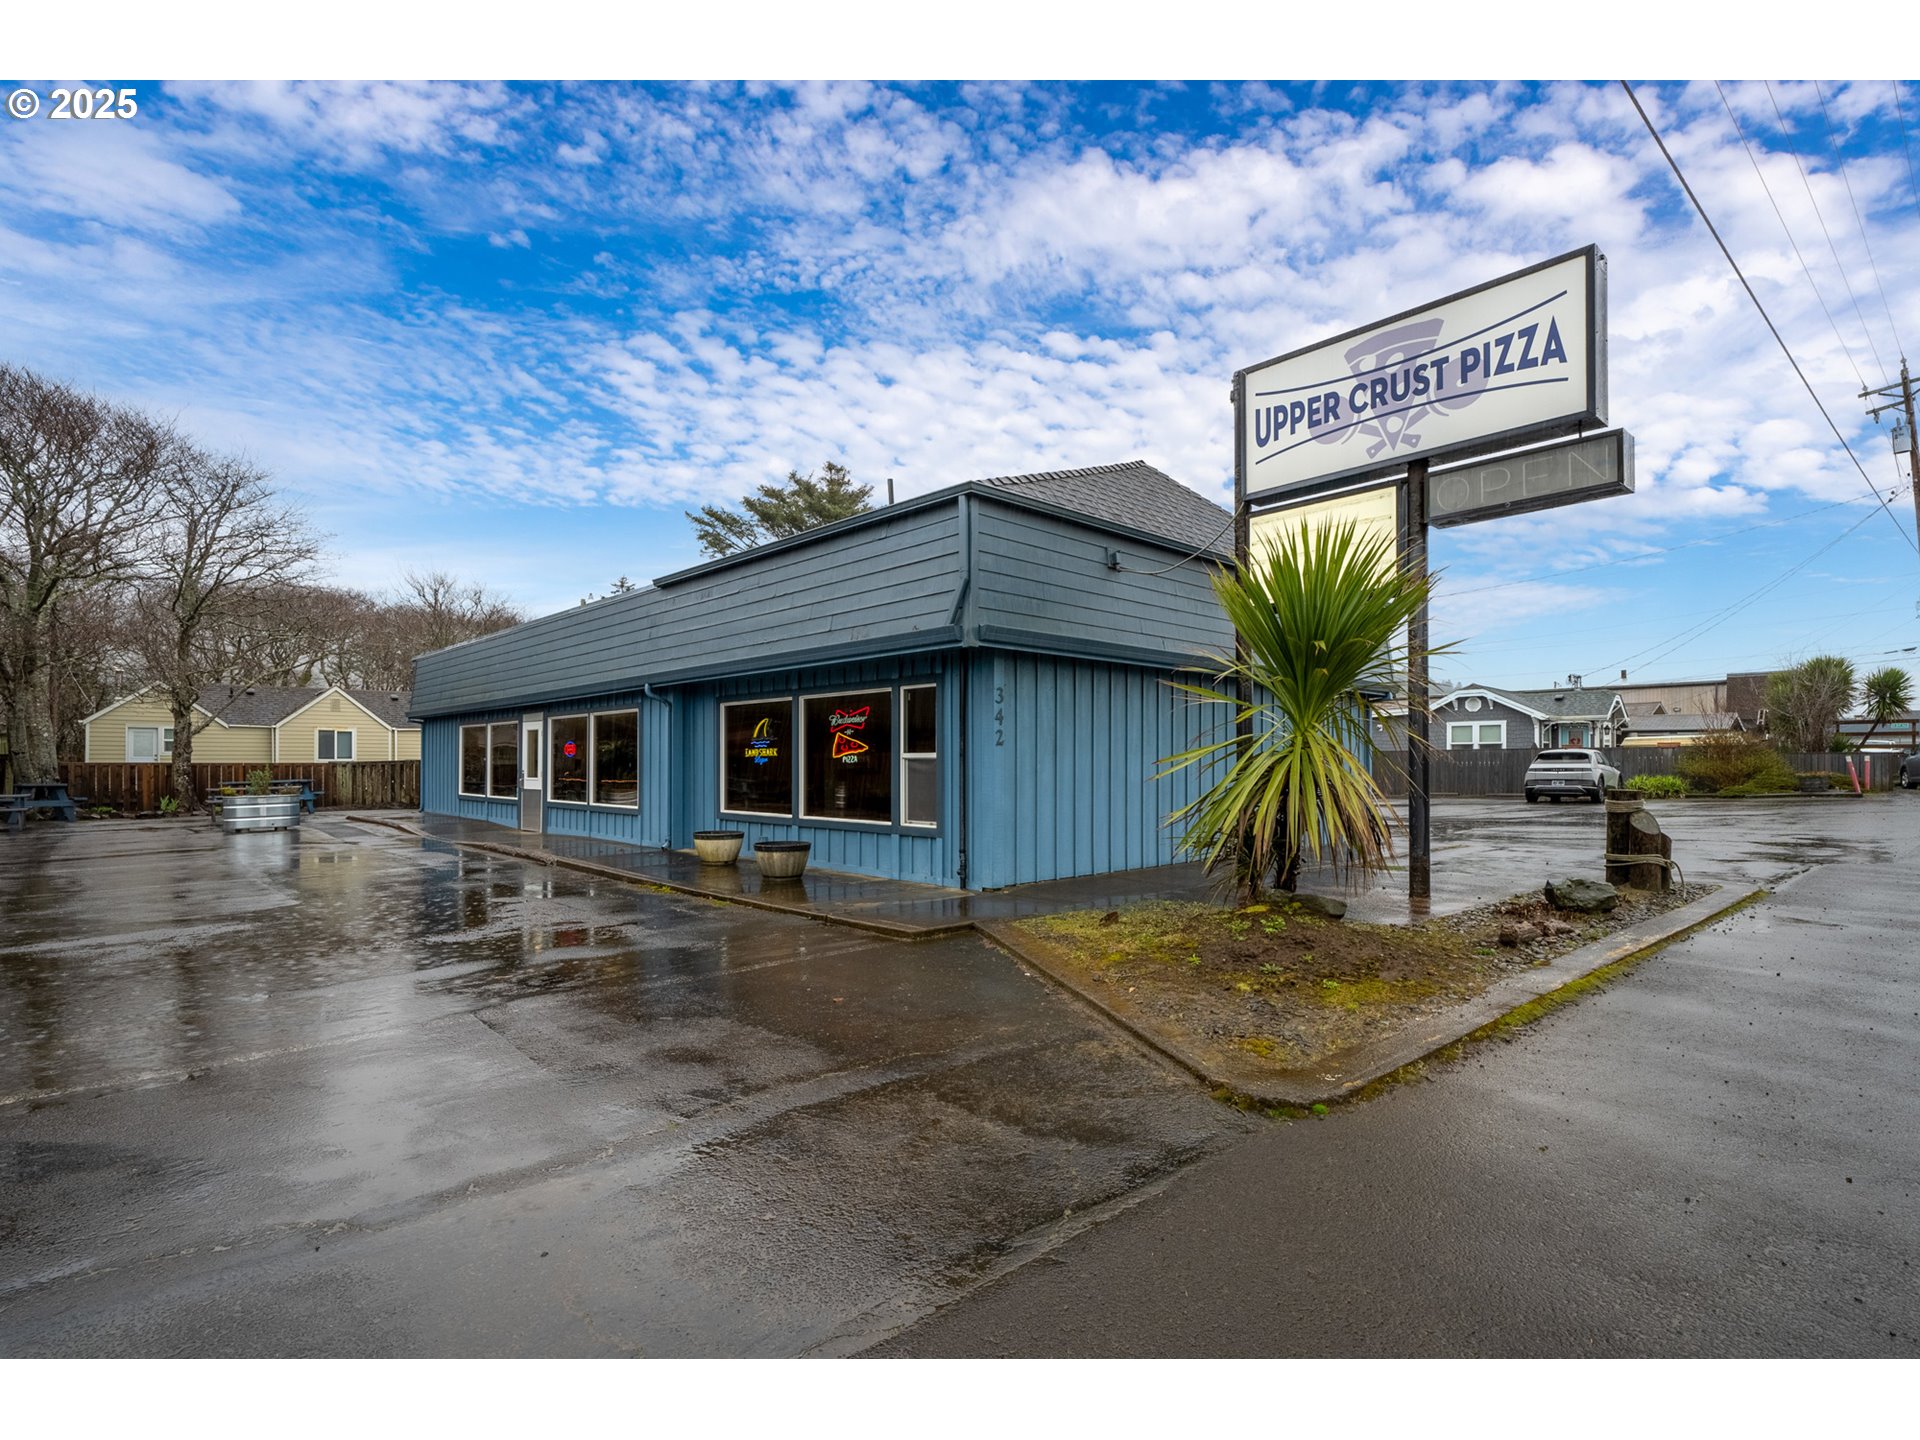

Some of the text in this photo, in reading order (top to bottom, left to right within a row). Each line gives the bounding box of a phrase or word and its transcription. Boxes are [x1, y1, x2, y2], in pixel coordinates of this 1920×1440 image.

[1255, 315, 1567, 448] UPPER CRUST PIZZA
[1437, 443, 1609, 513] OPEN
[995, 686, 1004, 746] 342
[842, 755, 858, 763] PIZZA
